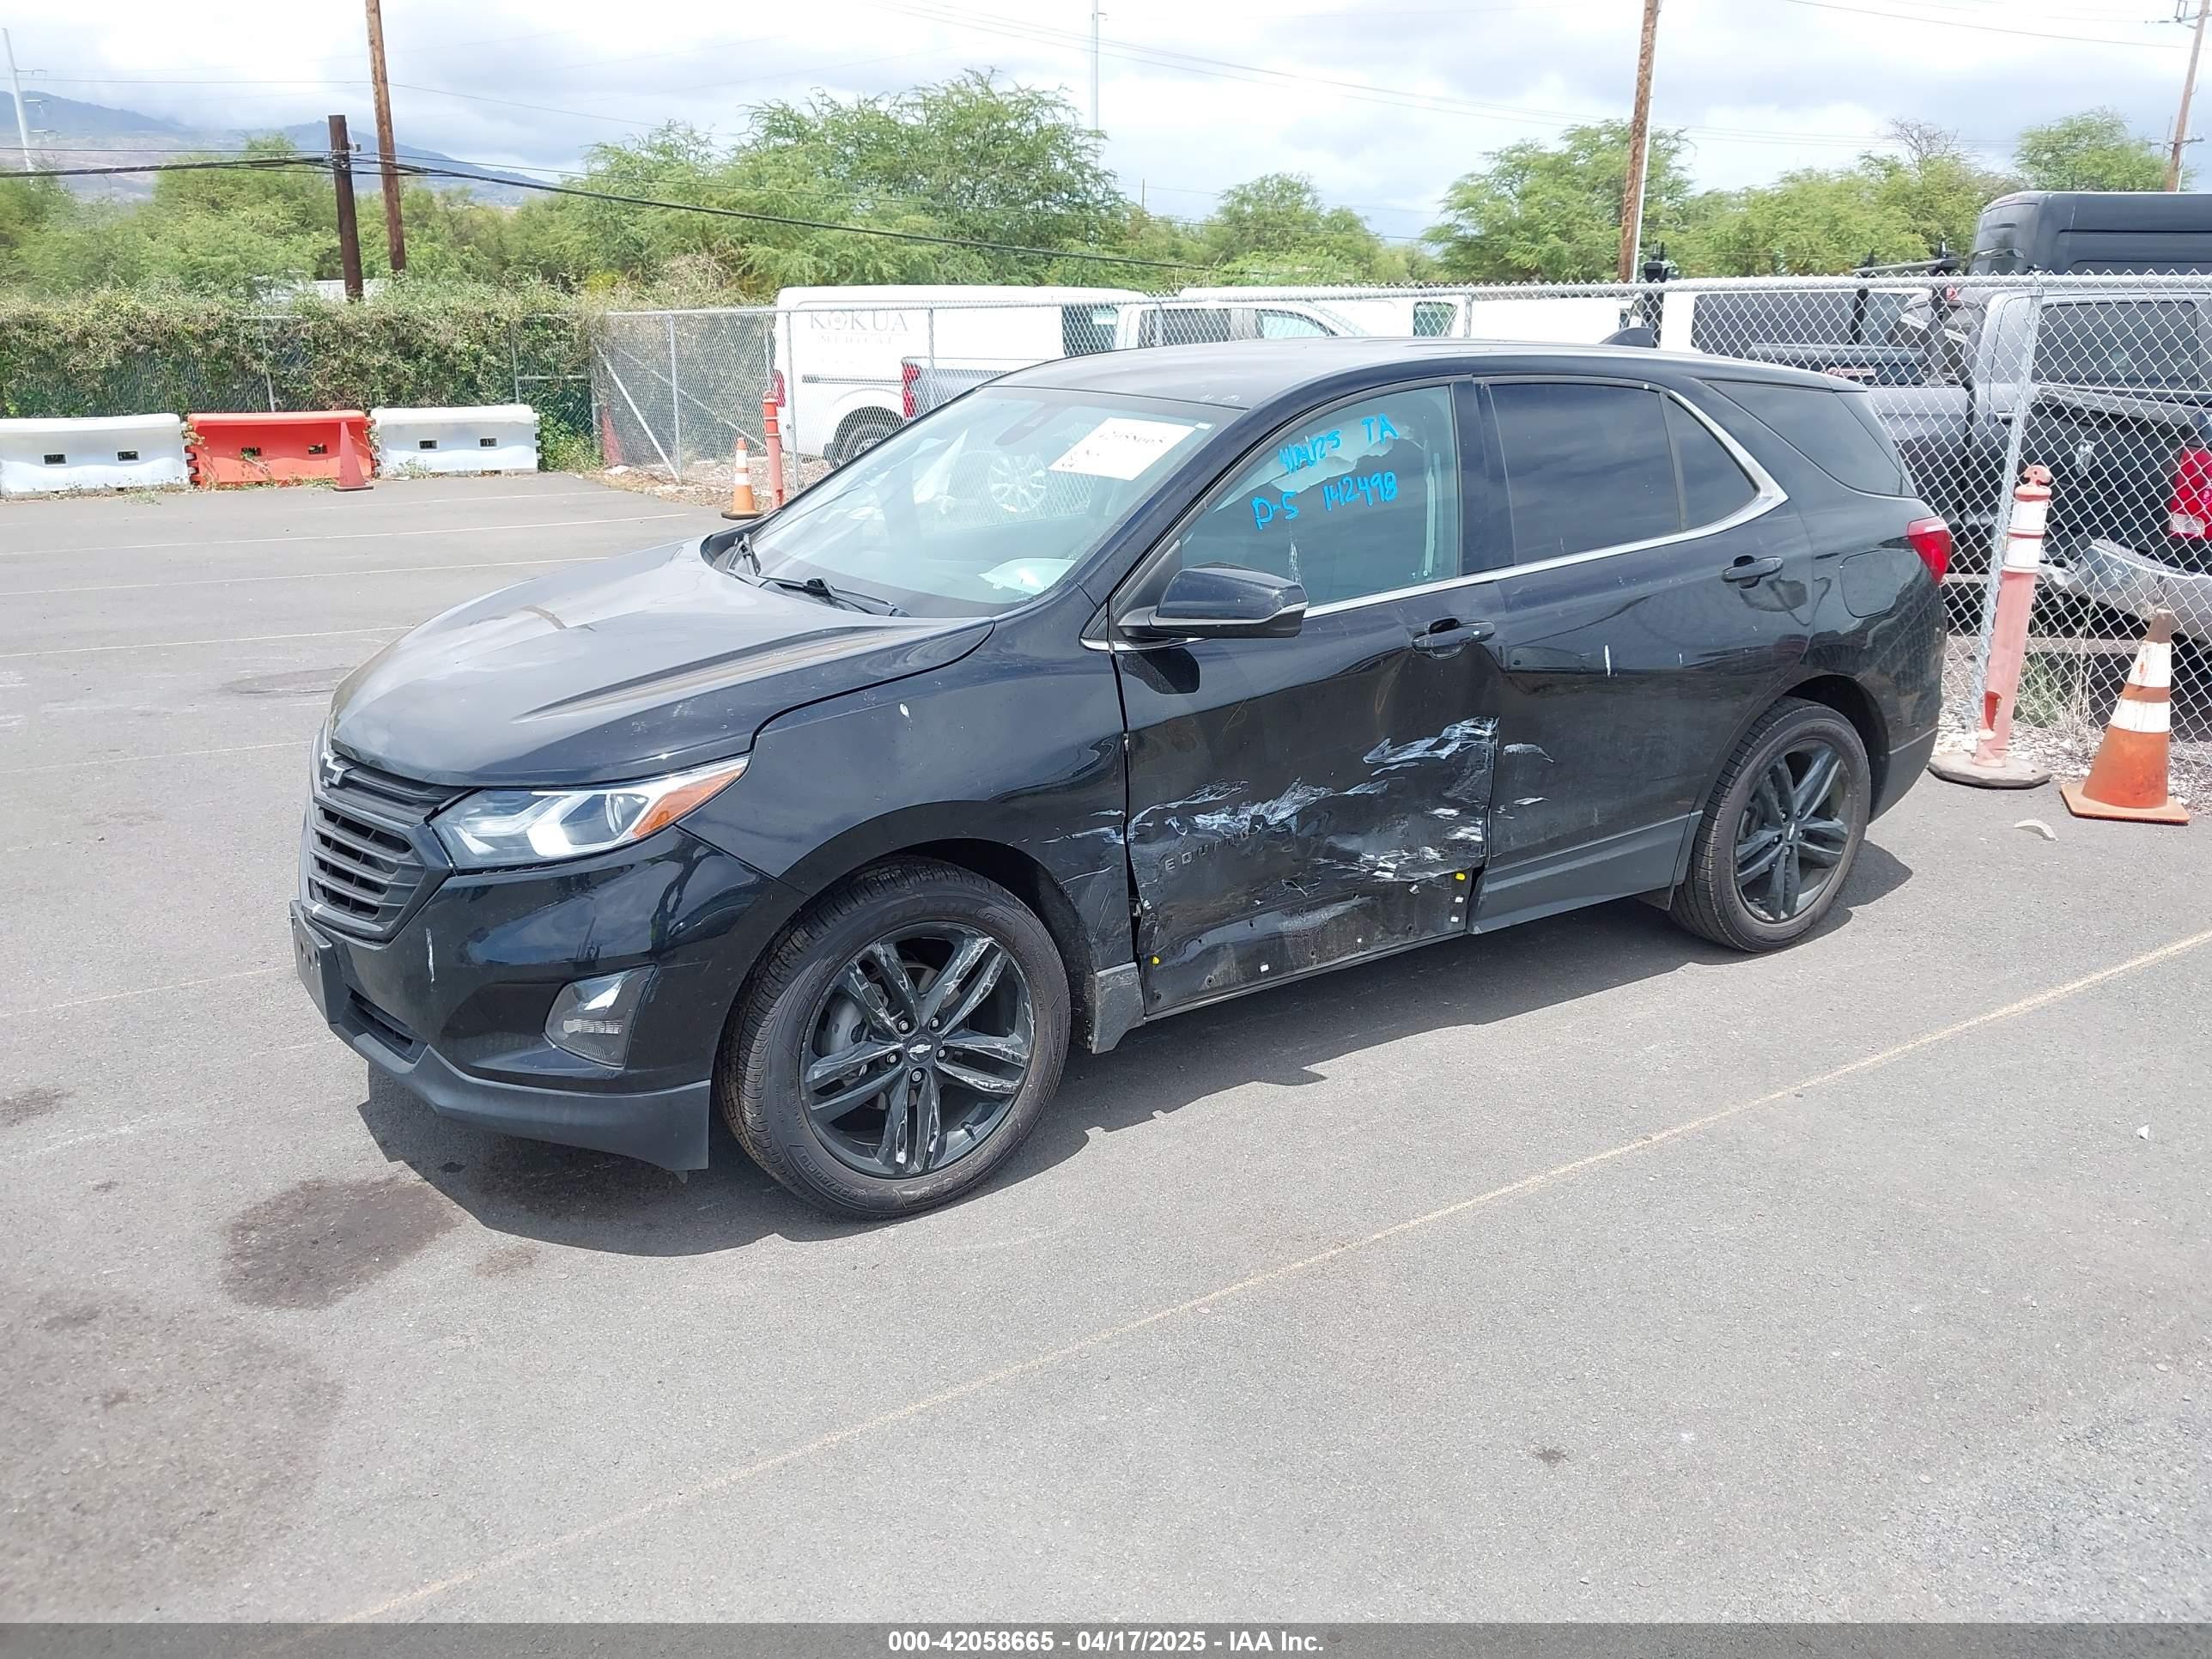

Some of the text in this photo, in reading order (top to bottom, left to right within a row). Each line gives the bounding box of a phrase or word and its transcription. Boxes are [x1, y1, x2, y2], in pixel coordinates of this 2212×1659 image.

[810, 310, 908, 331] KOKUA
[1360, 412, 1399, 445] TA
[1323, 471, 1398, 512] 142498
